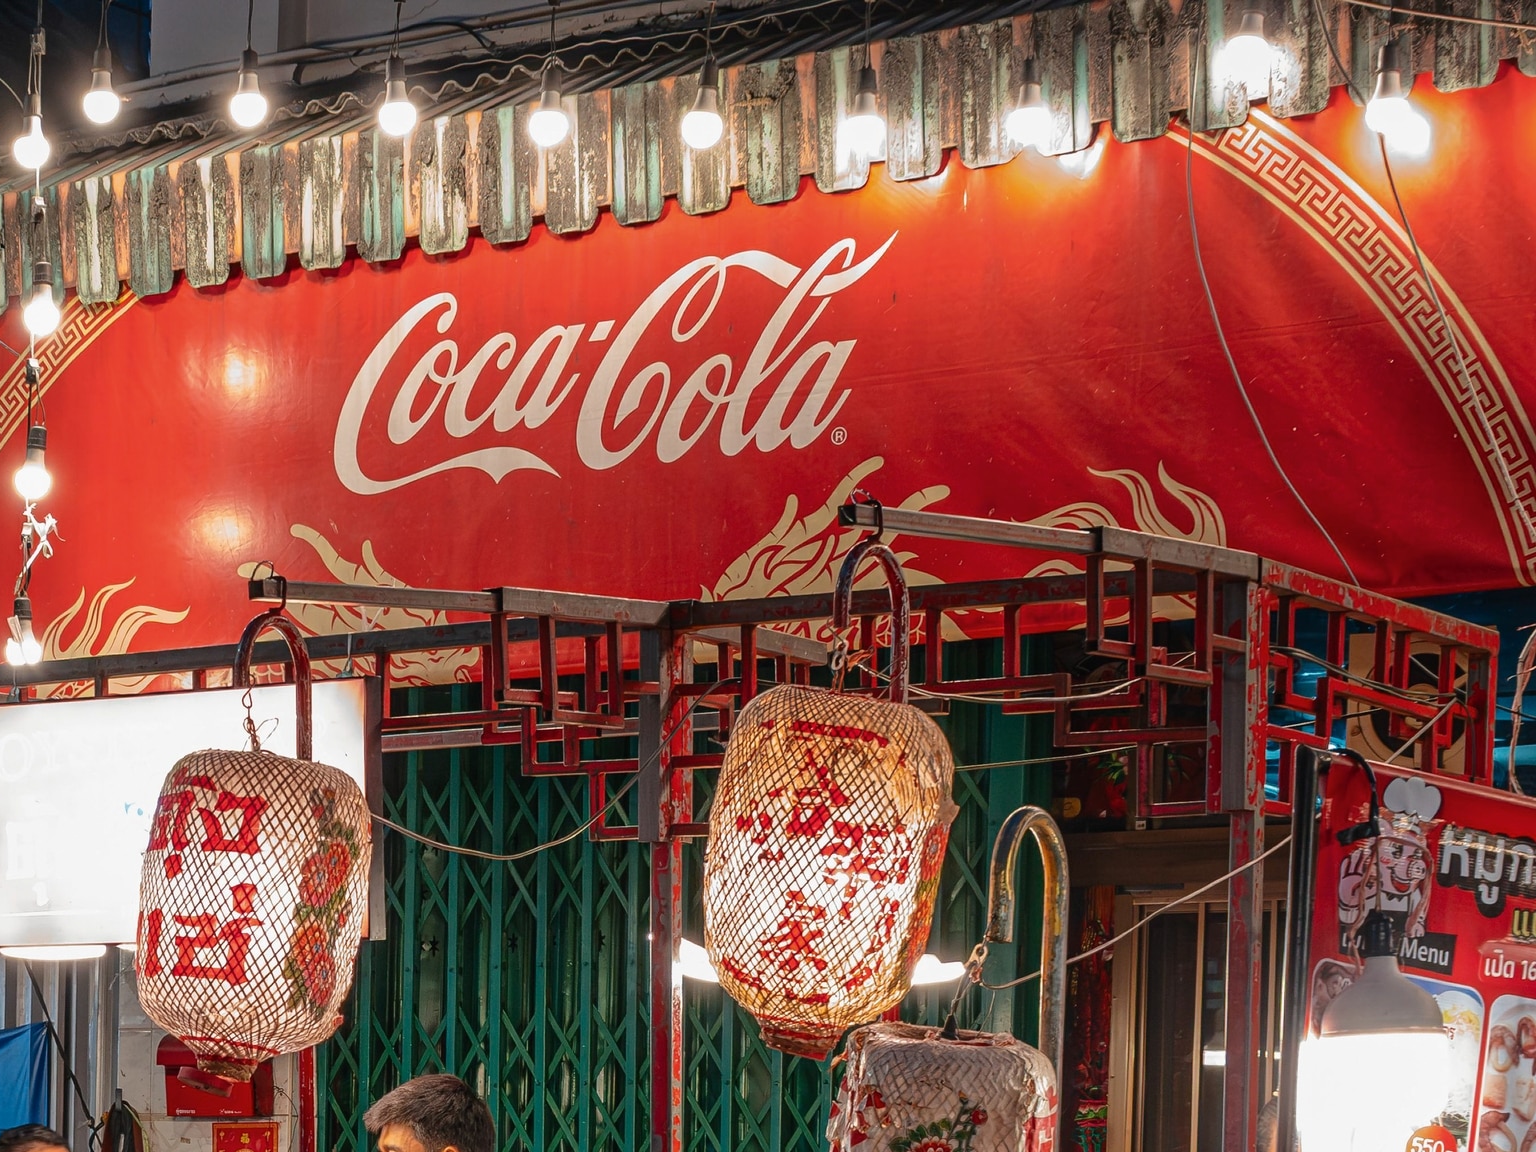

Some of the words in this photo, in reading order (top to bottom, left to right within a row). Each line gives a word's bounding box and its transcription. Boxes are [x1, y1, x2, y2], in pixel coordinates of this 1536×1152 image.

[334, 230, 900, 496] Coca-Cola
[1400, 937, 1450, 966] Menu
[1484, 950, 1515, 979] เปิด
